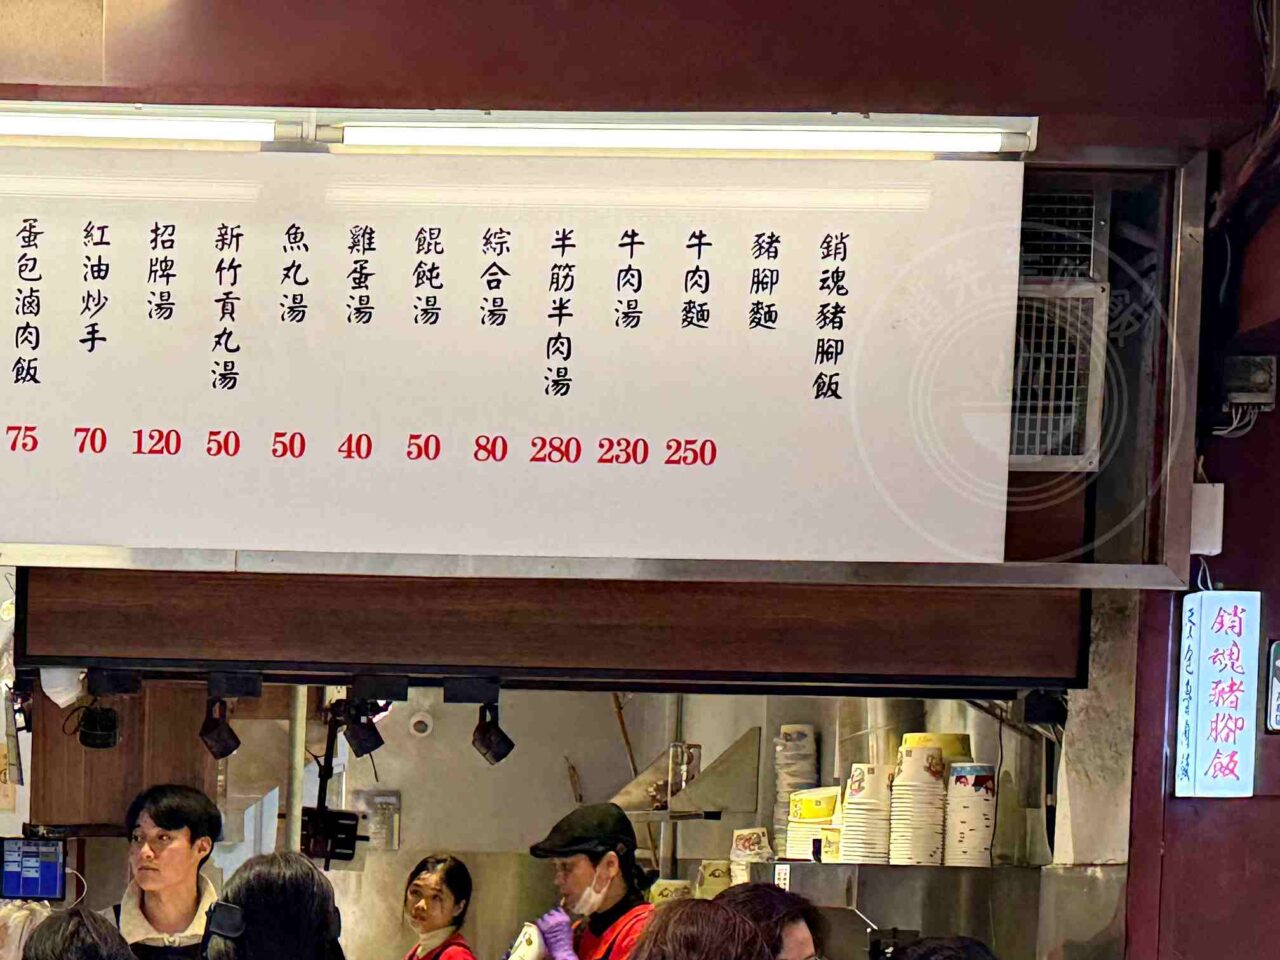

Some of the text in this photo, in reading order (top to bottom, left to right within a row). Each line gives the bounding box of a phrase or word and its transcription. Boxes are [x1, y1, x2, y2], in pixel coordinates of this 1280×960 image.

[147, 222, 177, 321] 招牌湯
[279, 224, 310, 323] 魚丸湯
[346, 225, 377, 325] 雞蛋湯
[413, 226, 445, 326] 餛飩湯
[480, 227, 512, 327] 綜合湯
[614, 229, 645, 329] 牛肉湯
[681, 229, 713, 329] 牛肉麵
[12, 218, 45, 384] 蛋包滷肉飯
[211, 222, 244, 391] 新竹貢丸湯
[544, 228, 577, 397] 半筋半肉湯
[6, 425, 39, 452] 75
[73, 427, 107, 454] 70
[132, 429, 181, 456] 120
[206, 431, 240, 457] 50
[272, 432, 306, 459] 50
[338, 434, 372, 460] 40
[406, 434, 441, 461] 50
[474, 435, 508, 461] 80
[530, 436, 582, 463] 280
[598, 438, 649, 464] 230
[665, 438, 717, 465] 250
